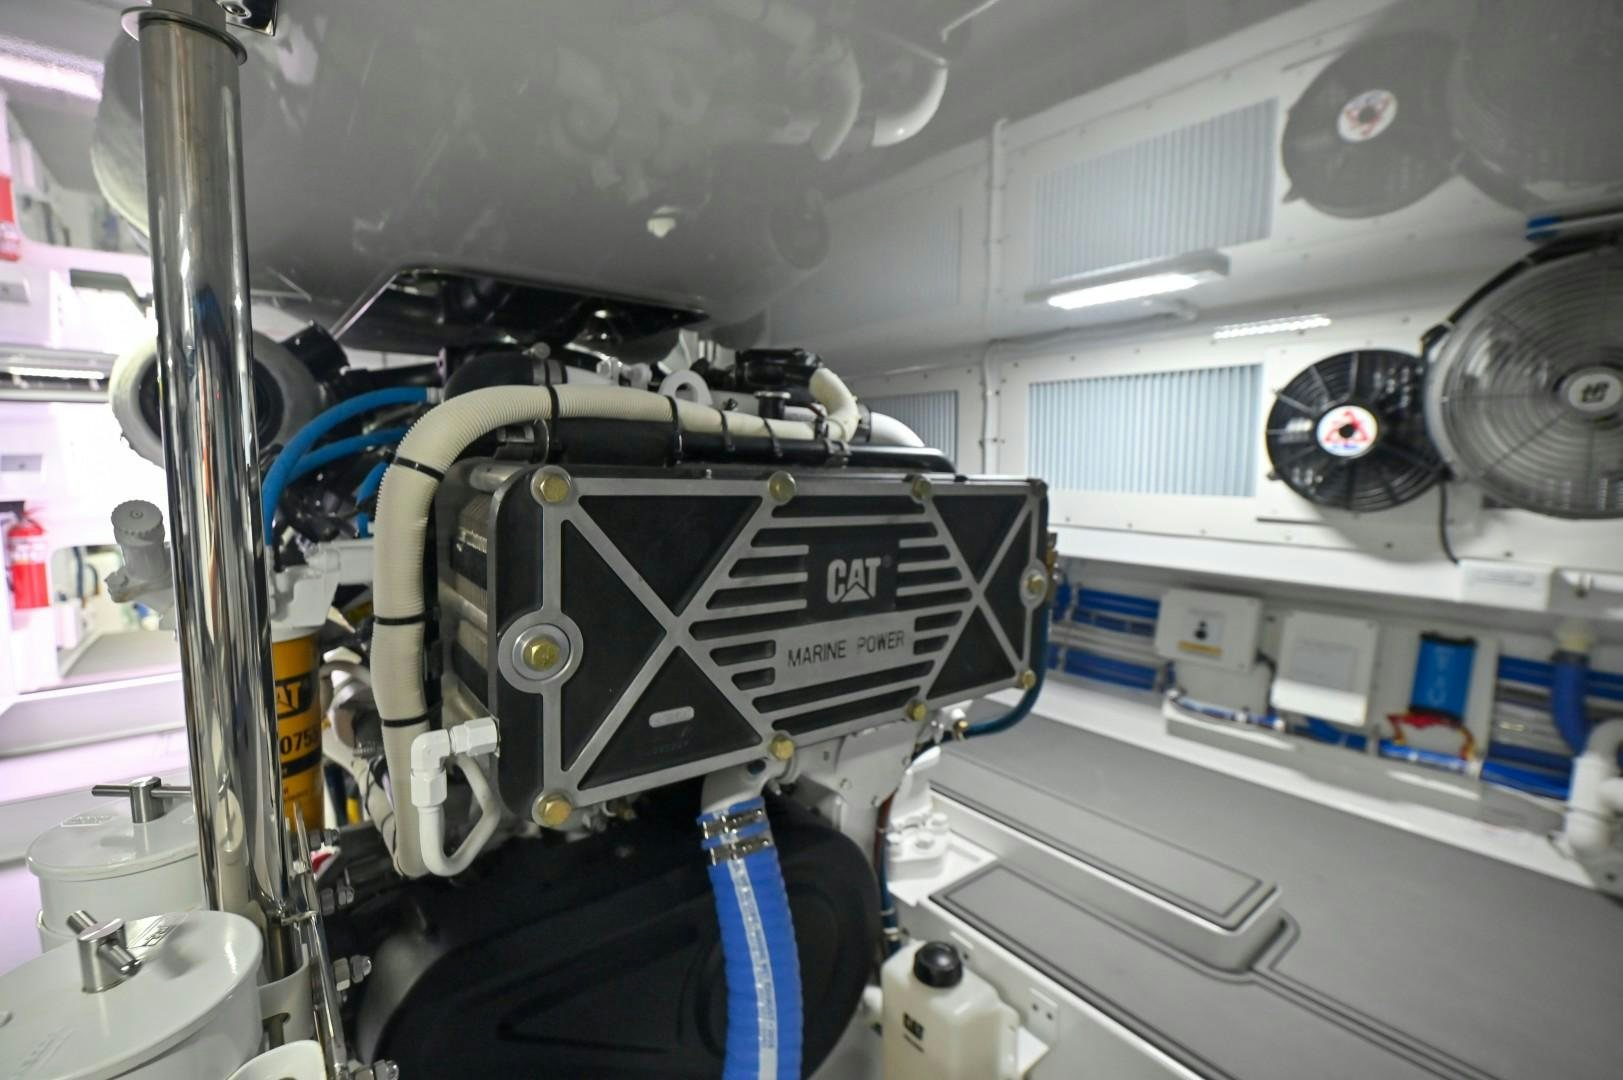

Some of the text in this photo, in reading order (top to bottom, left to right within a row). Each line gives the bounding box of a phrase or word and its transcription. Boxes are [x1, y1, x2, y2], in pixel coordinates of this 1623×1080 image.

[826, 557, 882, 604] CAT
[788, 630, 904, 668] MARINE POWER
[276, 681, 302, 714] AT
